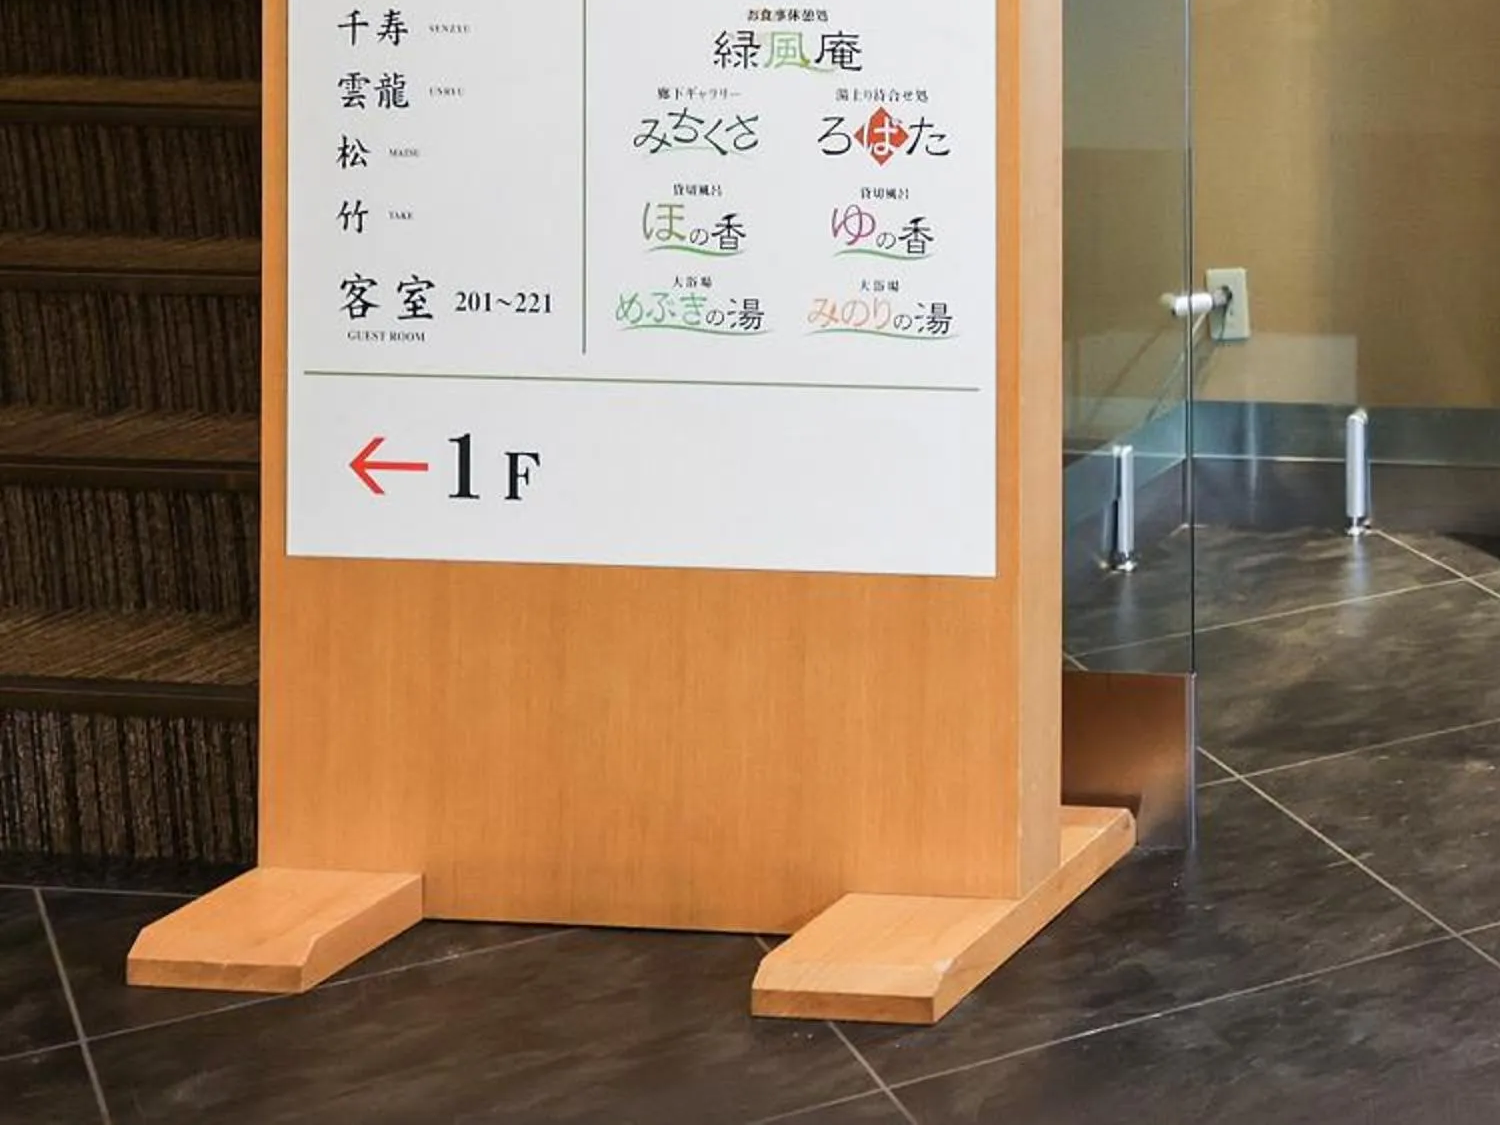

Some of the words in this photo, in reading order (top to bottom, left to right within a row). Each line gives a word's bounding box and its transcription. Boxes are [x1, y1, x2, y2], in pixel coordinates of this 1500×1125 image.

[337, 8, 409, 47] 千寿
[714, 29, 864, 74] 緑風庵
[337, 71, 410, 110] 雲龍
[633, 107, 760, 156] みちくさ
[817, 106, 951, 166] ろばた
[336, 135, 370, 170] 松
[337, 199, 369, 234] 竹
[389, 211, 412, 220] TAKE
[642, 202, 747, 250] ほの香
[831, 204, 935, 255] ゆの香
[339, 272, 436, 321] 客室
[673, 275, 713, 289] 大浴場
[861, 279, 899, 293] 大浴場
[615, 291, 765, 331] めぶきの湯
[807, 296, 953, 336] みのりの湯
[347, 330, 385, 342] GUEST
[389, 331, 425, 342] ROOM
[448, 432, 541, 501] 1F
